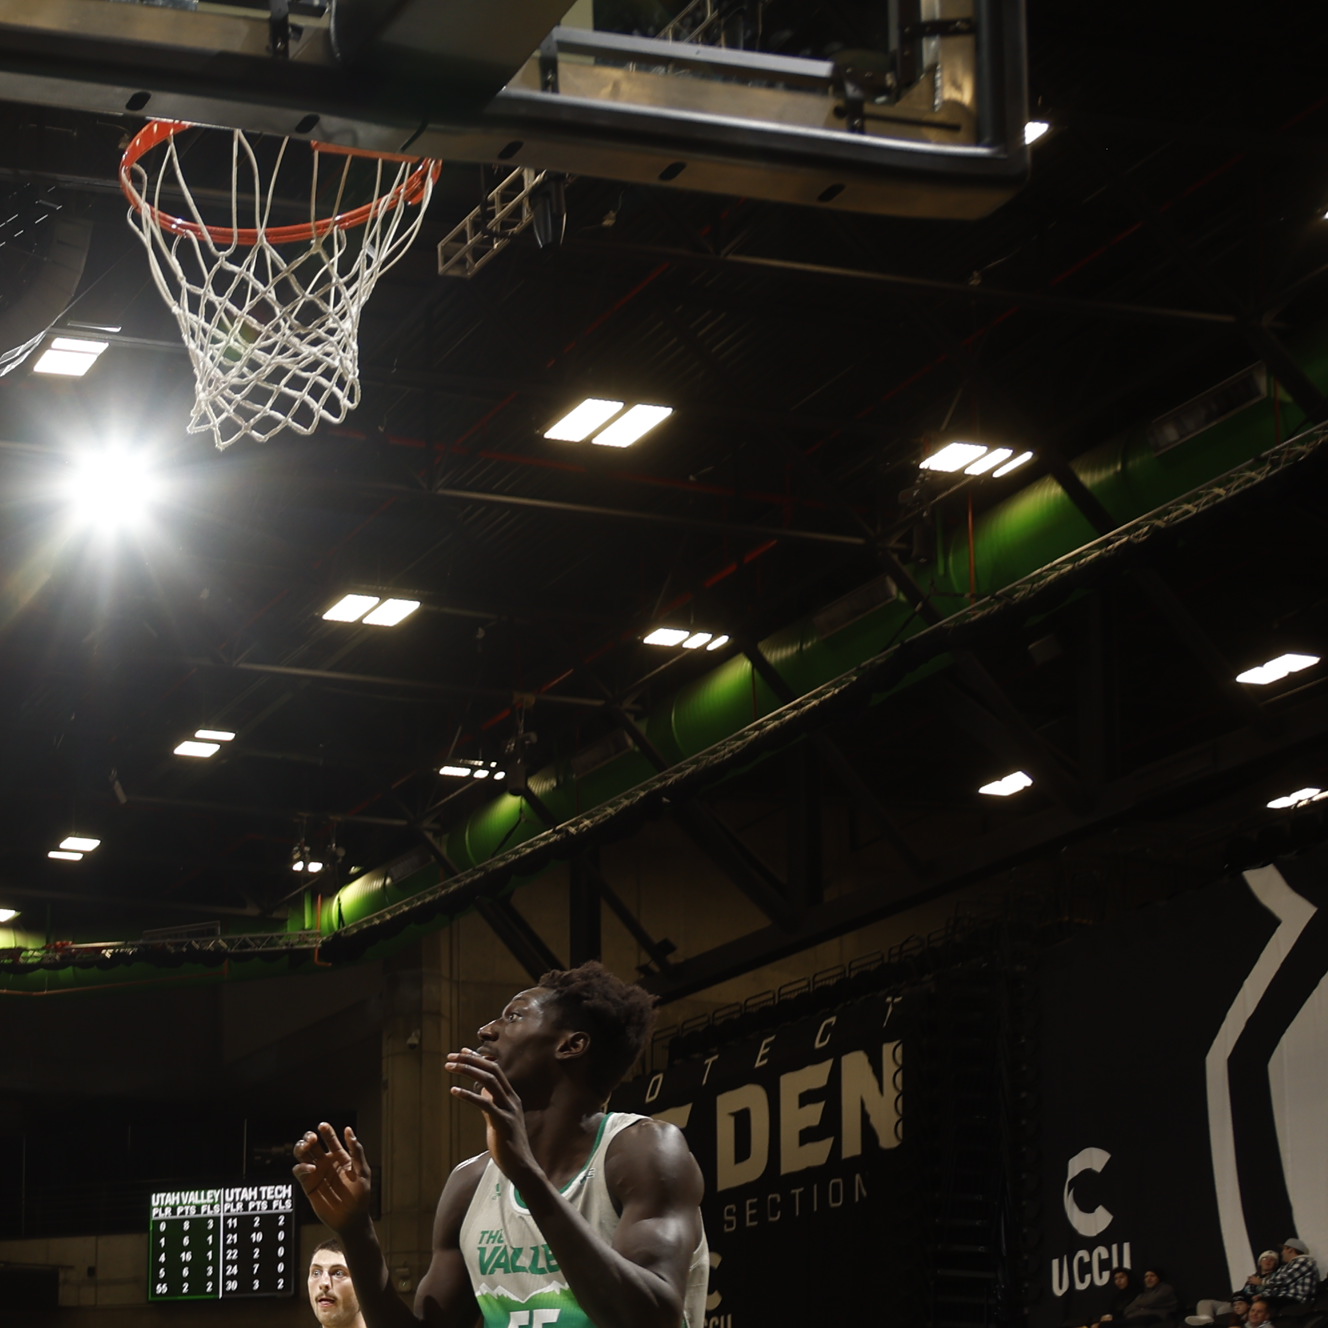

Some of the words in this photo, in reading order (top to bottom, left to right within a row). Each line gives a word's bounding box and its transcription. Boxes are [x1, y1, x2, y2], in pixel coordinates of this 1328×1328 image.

[716, 1039, 904, 1192] DEN
[152, 1192, 180, 1206] UTAH
[181, 1189, 221, 1205] VALLEY
[225, 1187, 258, 1202] UTAH
[259, 1184, 292, 1199] TECH
[224, 1202, 243, 1213] PLR
[249, 1200, 268, 1211] PTS
[273, 1199, 291, 1210] FLS
[724, 1173, 868, 1233] SECTION
[152, 1207, 172, 1218] PLR
[177, 1206, 196, 1216] PTS
[201, 1204, 220, 1214] FLS
[207, 1219, 214, 1229] 3
[227, 1218, 238, 1229] 11
[254, 1217, 260, 1228] 2
[278, 1215, 284, 1226] 2
[159, 1237, 165, 1248] 1
[207, 1235, 212, 1245] 1
[226, 1234, 238, 1244] 21
[251, 1232, 263, 1243] 10
[278, 1231, 284, 1241] 0
[478, 1229, 505, 1245] THE
[159, 1253, 165, 1263] 4
[180, 1251, 192, 1262] 16
[207, 1251, 212, 1261] 1
[226, 1249, 238, 1260] 22
[253, 1248, 259, 1259] 2
[278, 1246, 284, 1257] 0
[477, 1243, 562, 1276] VALLE
[206, 1266, 213, 1277] 3
[226, 1265, 238, 1276] 24
[253, 1264, 259, 1274] 7
[1052, 1242, 1132, 1297] UCCU
